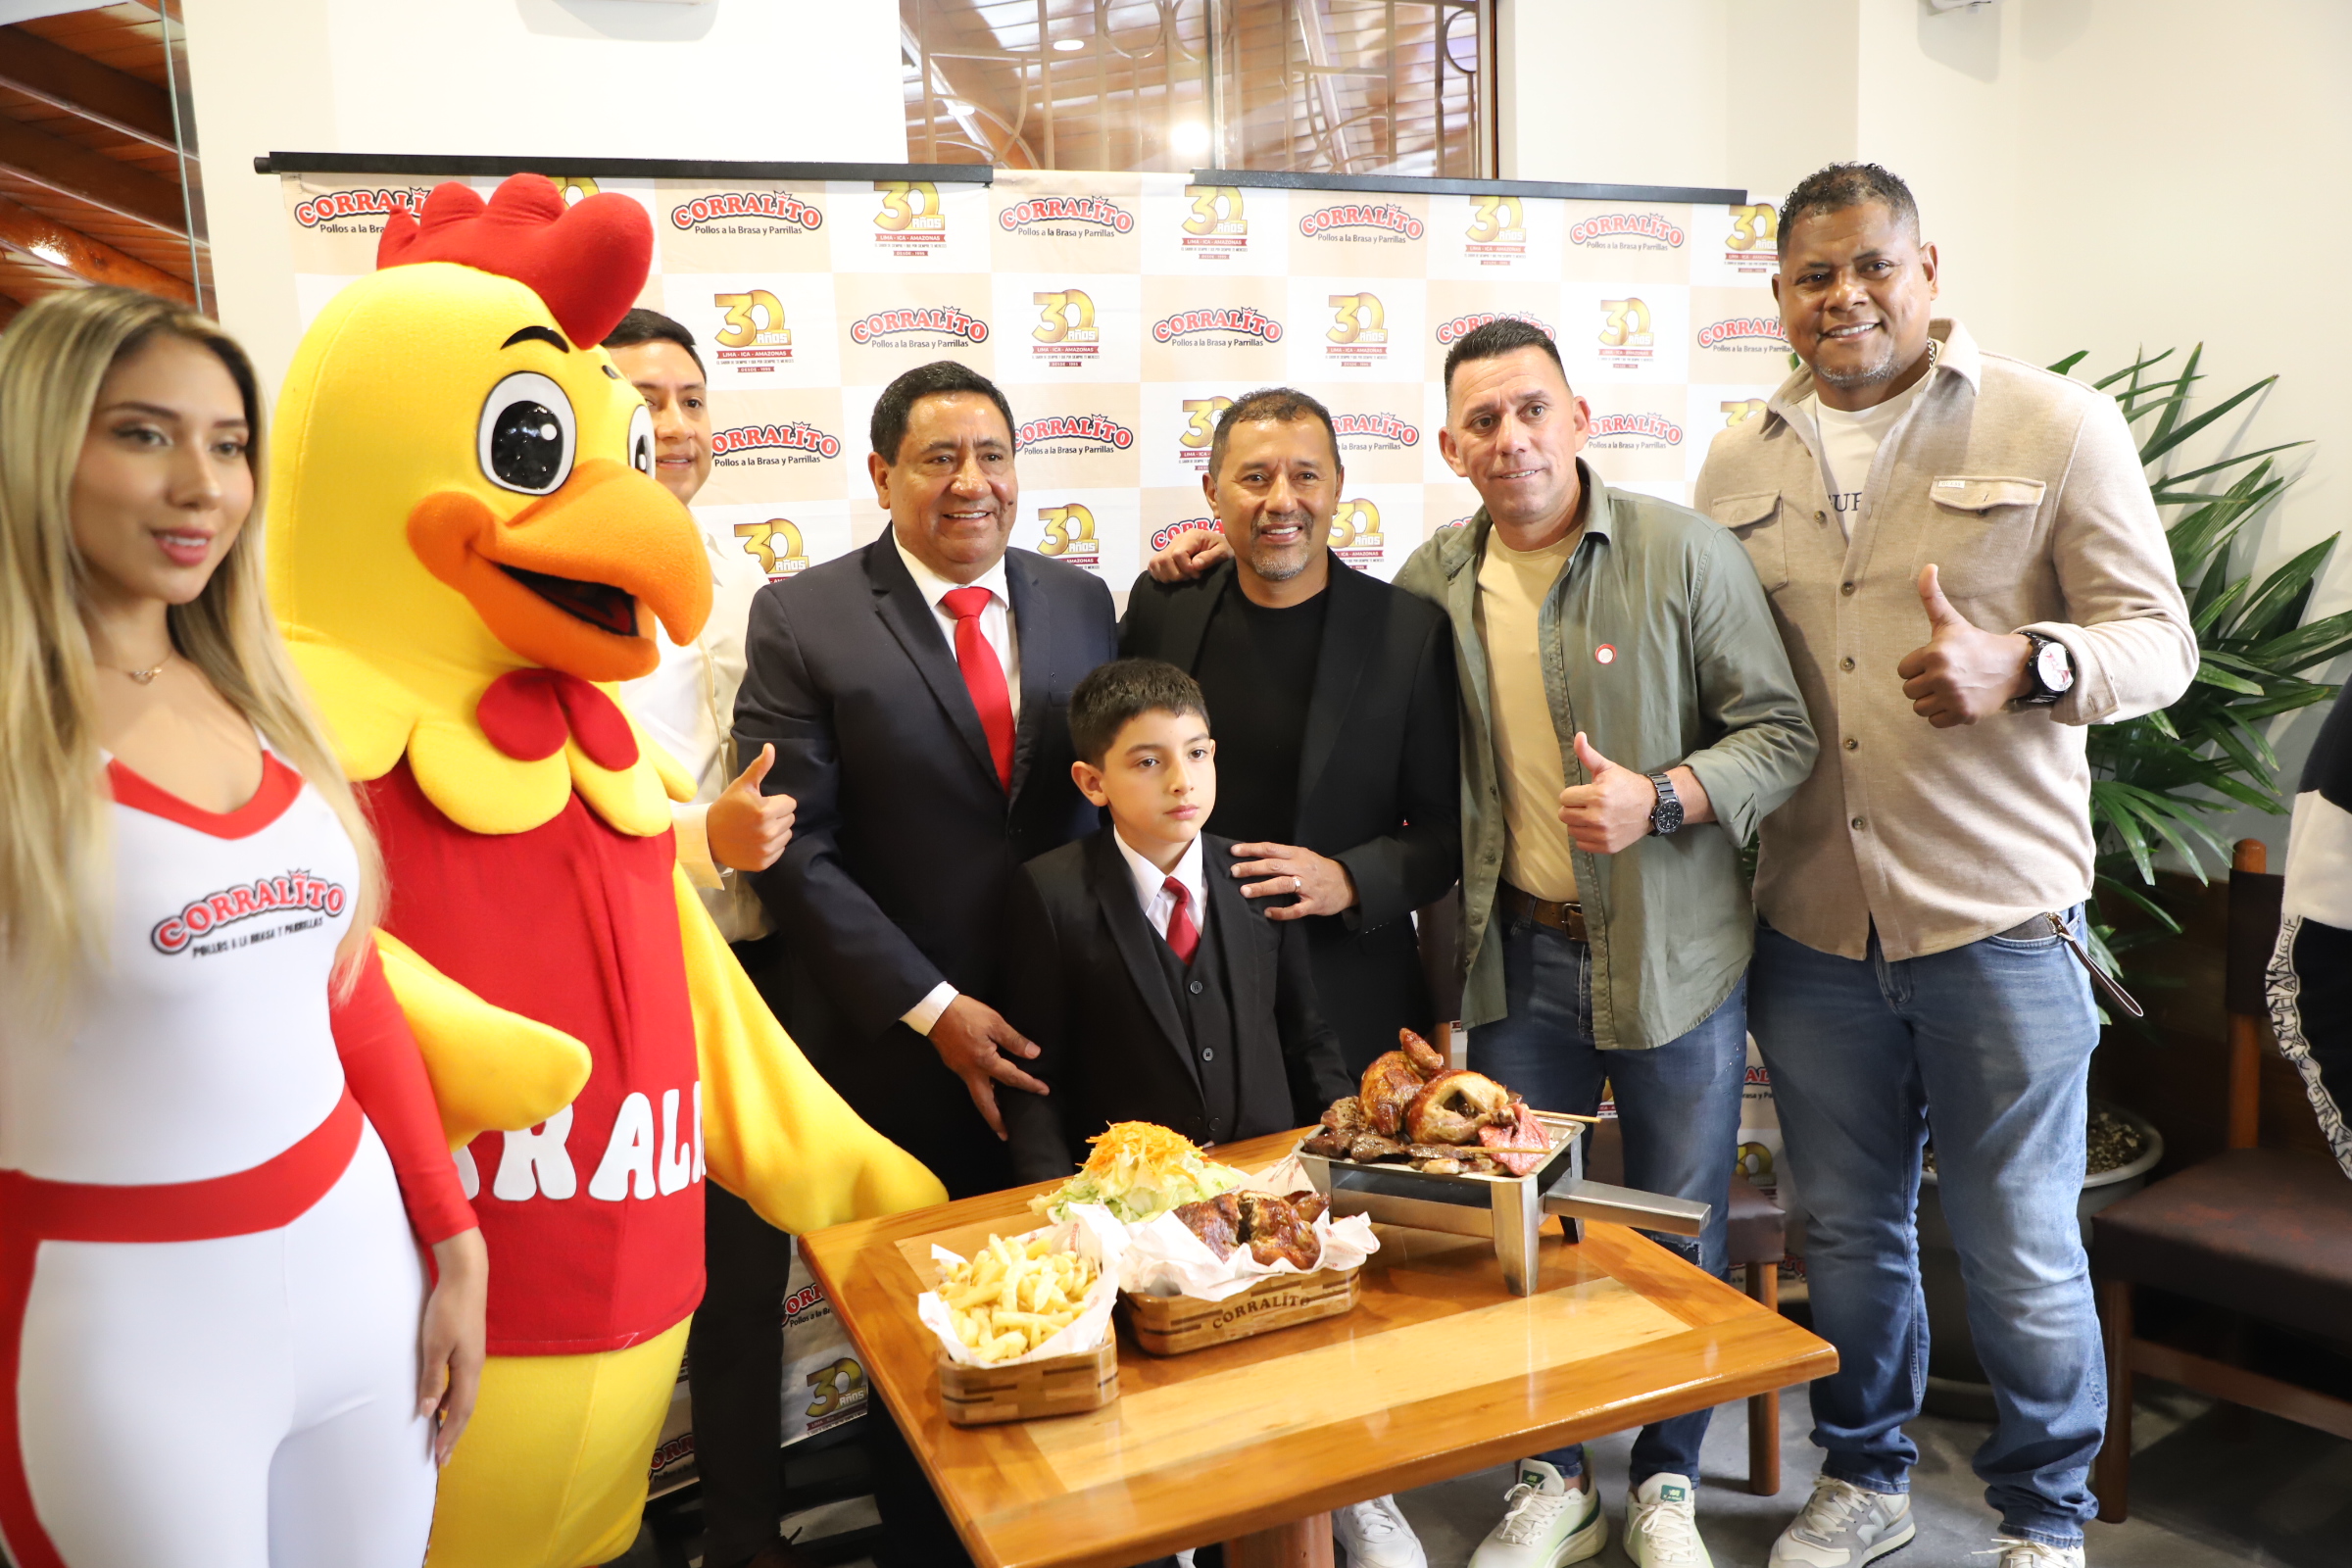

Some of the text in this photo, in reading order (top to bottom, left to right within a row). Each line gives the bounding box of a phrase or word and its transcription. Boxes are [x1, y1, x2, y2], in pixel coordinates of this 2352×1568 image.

[294, 187, 425, 228] CORRALI
[671, 192, 822, 230] CORRALITO
[873, 181, 940, 231] 30
[911, 216, 942, 228] AÑOS
[1000, 197, 1134, 234] CORRALITO
[1181, 184, 1244, 236] 30
[1299, 204, 1424, 240] CORRALITO
[1465, 196, 1523, 243] 30
[320, 224, 349, 233] Pollos
[359, 224, 368, 233] la
[369, 224, 386, 233] Bra
[695, 225, 719, 234] Pollos
[728, 225, 735, 234] la
[769, 225, 803, 234] Parrillas
[1055, 228, 1077, 237] Brasa
[1318, 233, 1338, 242] Pollos
[1570, 213, 1684, 248] CORRALITO
[1725, 203, 1778, 252] 30
[714, 289, 785, 349] 30
[851, 307, 989, 344] CORRALITO
[1032, 289, 1095, 344] 30
[1152, 308, 1283, 343] CORRALITO
[1326, 292, 1385, 344] 30
[1598, 297, 1651, 347] 30
[1697, 317, 1789, 348] CORRALI
[757, 331, 788, 344] AÑOS
[872, 339, 894, 348] Pollos
[901, 339, 907, 348] la
[938, 339, 969, 348] Parrillas
[1067, 328, 1096, 341] AÑOS
[712, 421, 841, 459] ORRALITO
[1331, 412, 1420, 447] RRALITO
[1588, 413, 1683, 446] ORRALITO
[714, 459, 739, 467] Pollos
[757, 457, 780, 466] Brasa
[788, 455, 821, 464] Parrillas
[1084, 445, 1114, 454] Parrillas
[734, 518, 803, 574] 30
[1037, 503, 1095, 557] 30
[1069, 541, 1097, 553] AÑOS
[775, 559, 807, 571] AÑOS
[151, 869, 347, 956] CORRALITO
[789, 1316, 809, 1328] Pollos
[815, 1309, 822, 1318] la
[1212, 1293, 1310, 1329] CORRALITO
[806, 1357, 863, 1417] 30
[839, 1390, 865, 1407] AÑOS
